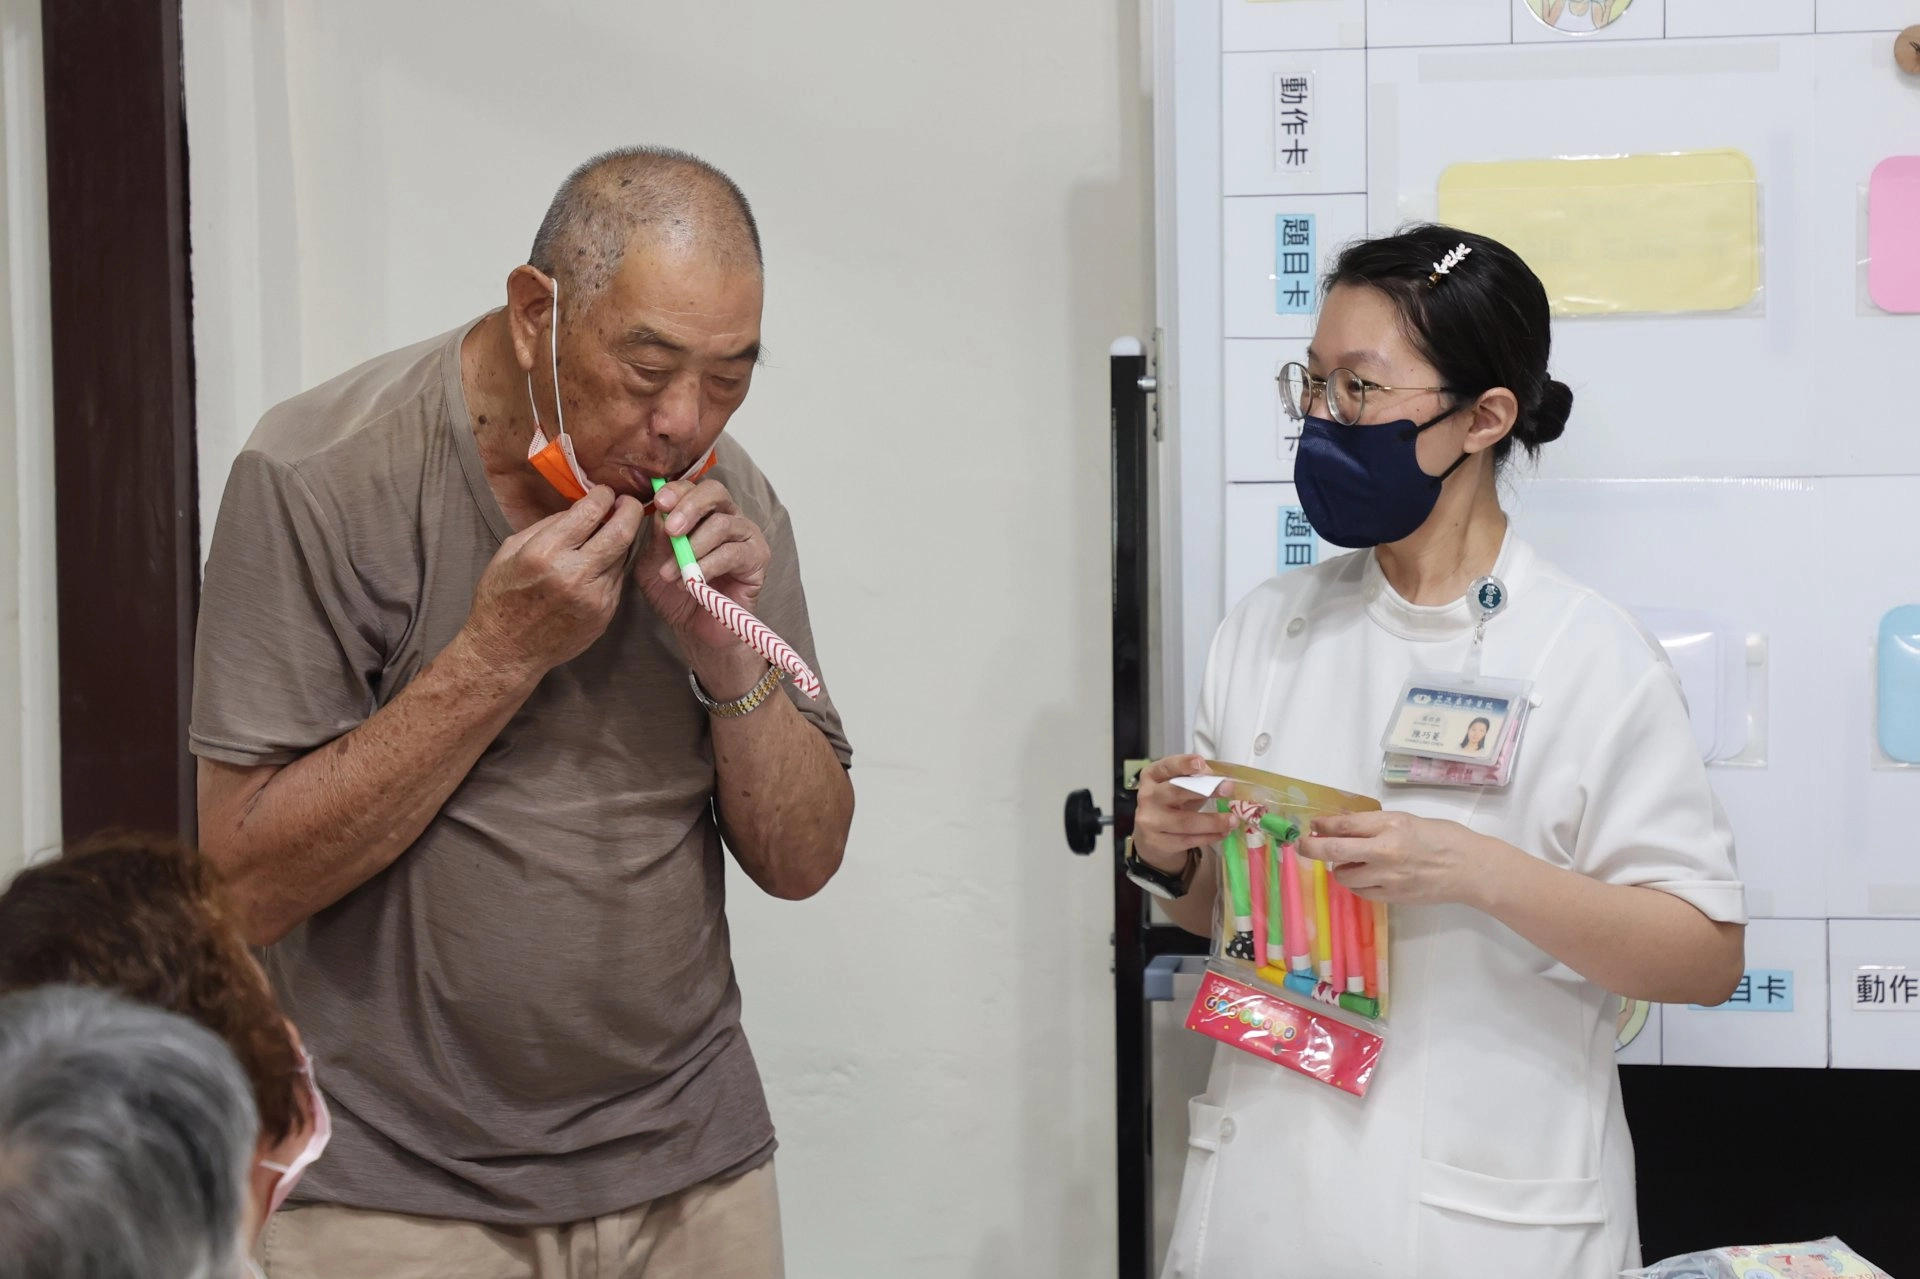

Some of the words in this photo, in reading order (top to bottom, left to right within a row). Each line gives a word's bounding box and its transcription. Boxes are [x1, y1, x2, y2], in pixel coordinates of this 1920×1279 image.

[1280, 77, 1309, 166] 動作卡
[1282, 218, 1310, 307] 題目卡
[1284, 510, 1312, 565] 題目
[1728, 975, 1787, 1004] 目卡
[1856, 974, 1919, 1004] 動作
